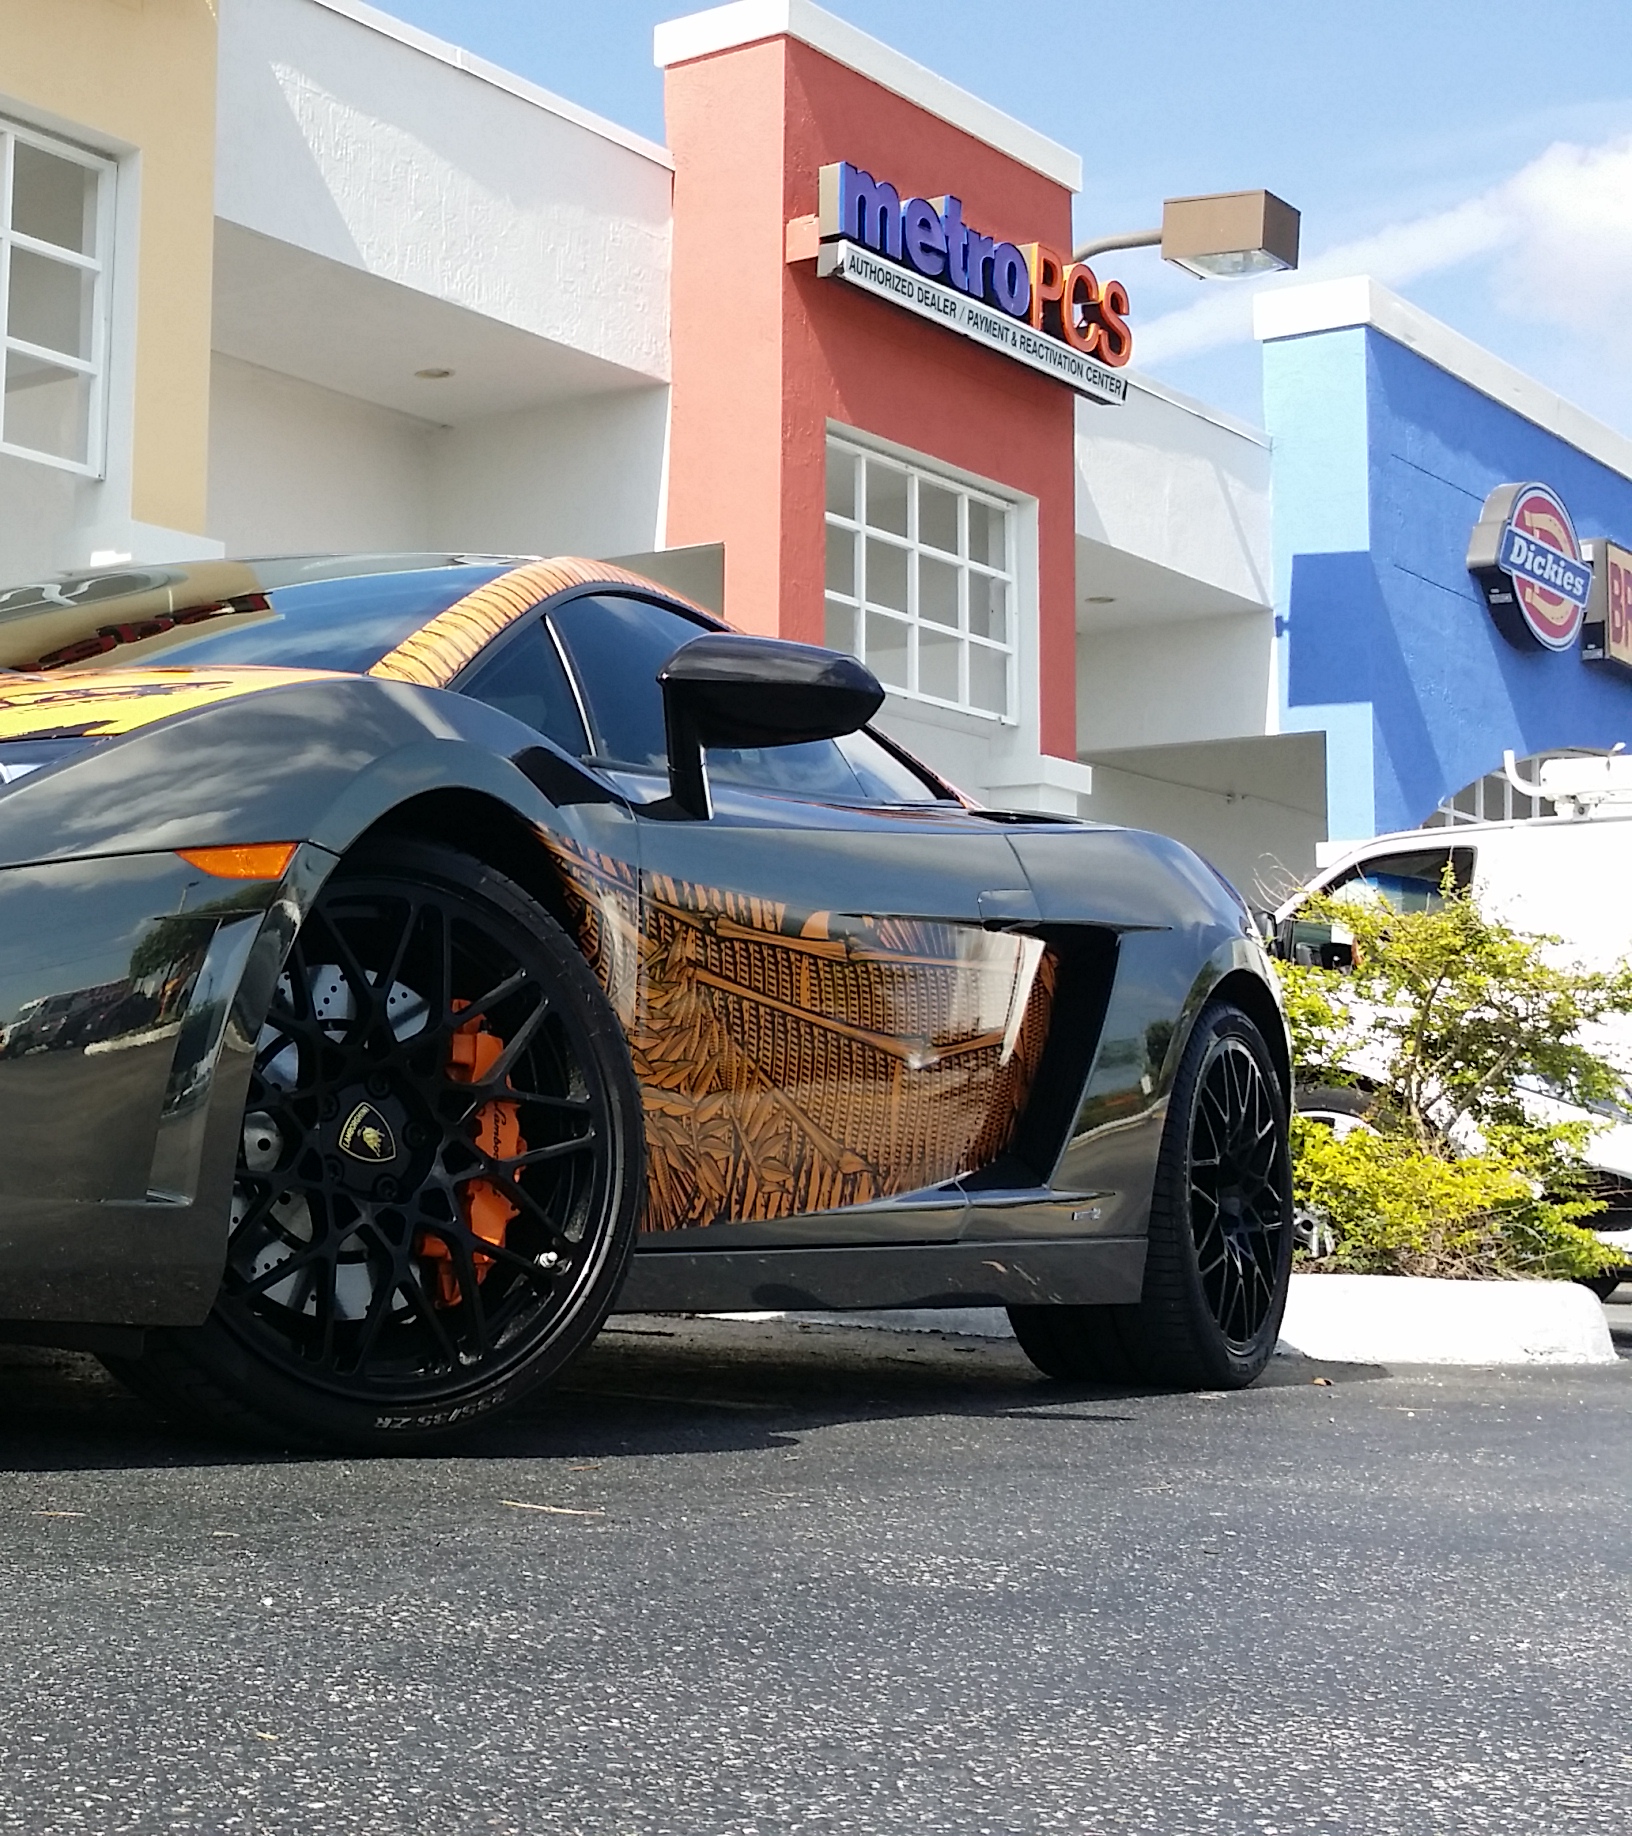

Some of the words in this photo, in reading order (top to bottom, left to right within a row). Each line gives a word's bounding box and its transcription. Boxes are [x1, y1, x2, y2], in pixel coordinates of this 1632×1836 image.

[838, 161, 1132, 367] metroPCS
[849, 255, 914, 298] AUTHORIZED
[917, 286, 957, 319] DEALER
[959, 306, 965, 321] /
[968, 309, 1010, 343] PAYMENT
[1011, 331, 1017, 348] &
[1020, 333, 1084, 378] REACTIVATION
[1086, 366, 1121, 394] CENTER
[1509, 535, 1585, 597] Dickies
[342, 1105, 370, 1149] LAMBORGHINI
[374, 1417, 412, 1429] ZR
